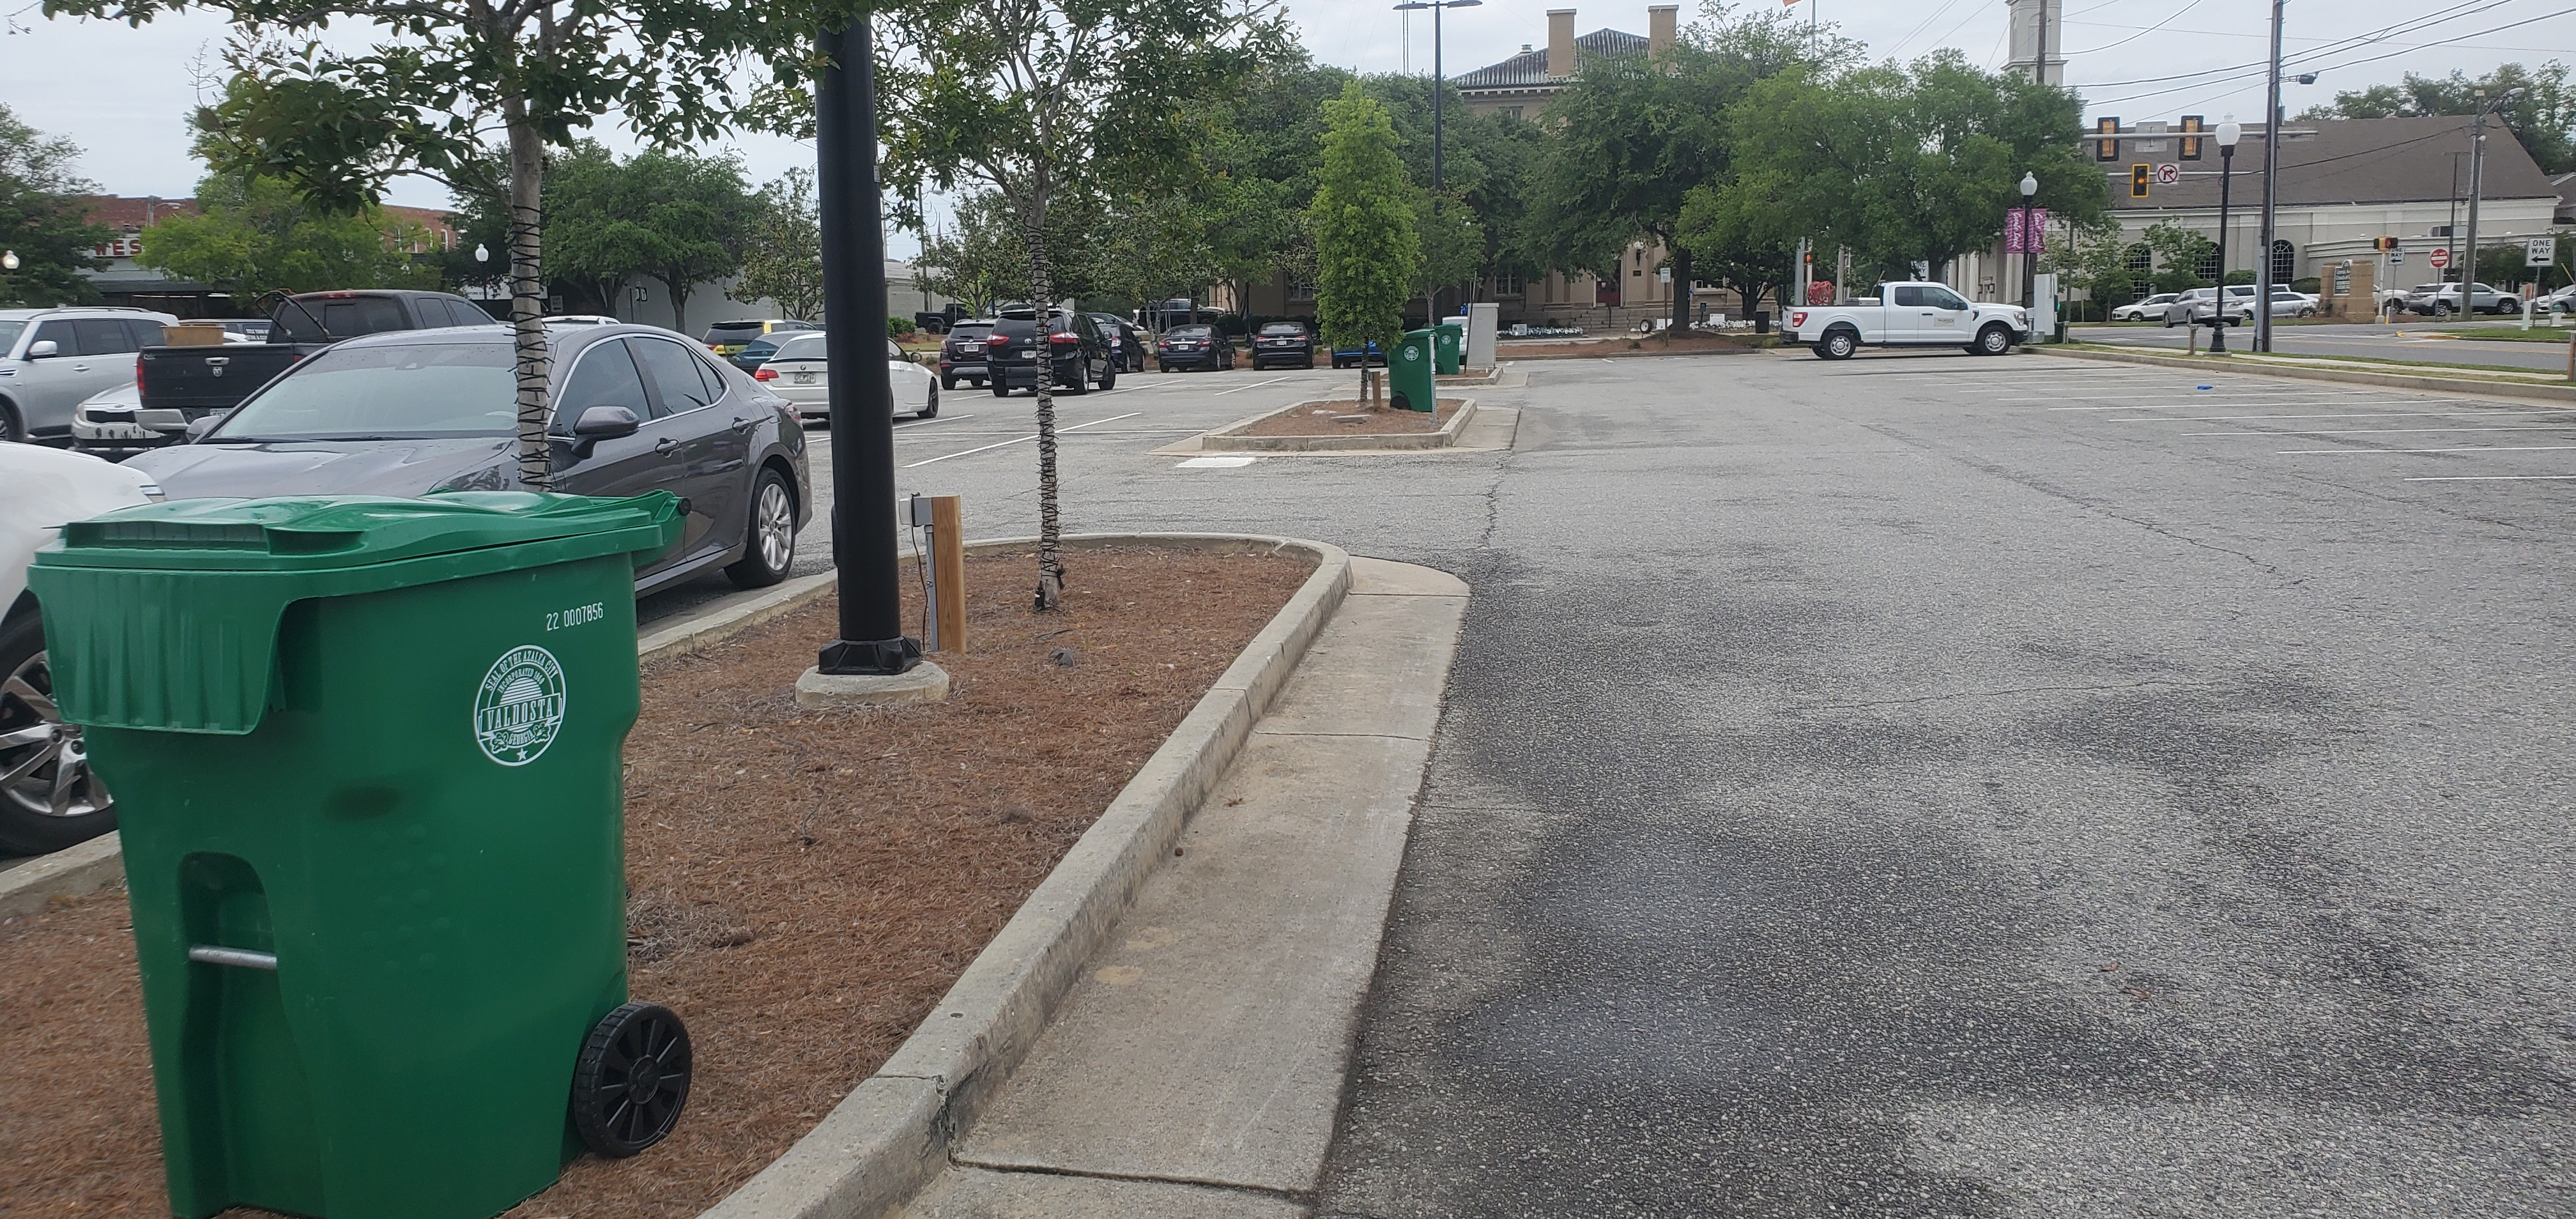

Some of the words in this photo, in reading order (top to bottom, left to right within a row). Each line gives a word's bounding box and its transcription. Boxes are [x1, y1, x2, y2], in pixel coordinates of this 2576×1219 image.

[546, 612, 560, 631] 22
[564, 602, 603, 627] 0007856
[486, 669, 502, 691] SEAL
[500, 660, 509, 673] OF
[508, 651, 522, 667] THE
[523, 650, 546, 666] AZALEA
[544, 660, 558, 678] CITY
[497, 668, 534, 694] INCORPORATED
[487, 696, 553, 731] VALDOSTA
[509, 729, 535, 746] GEORGIA
